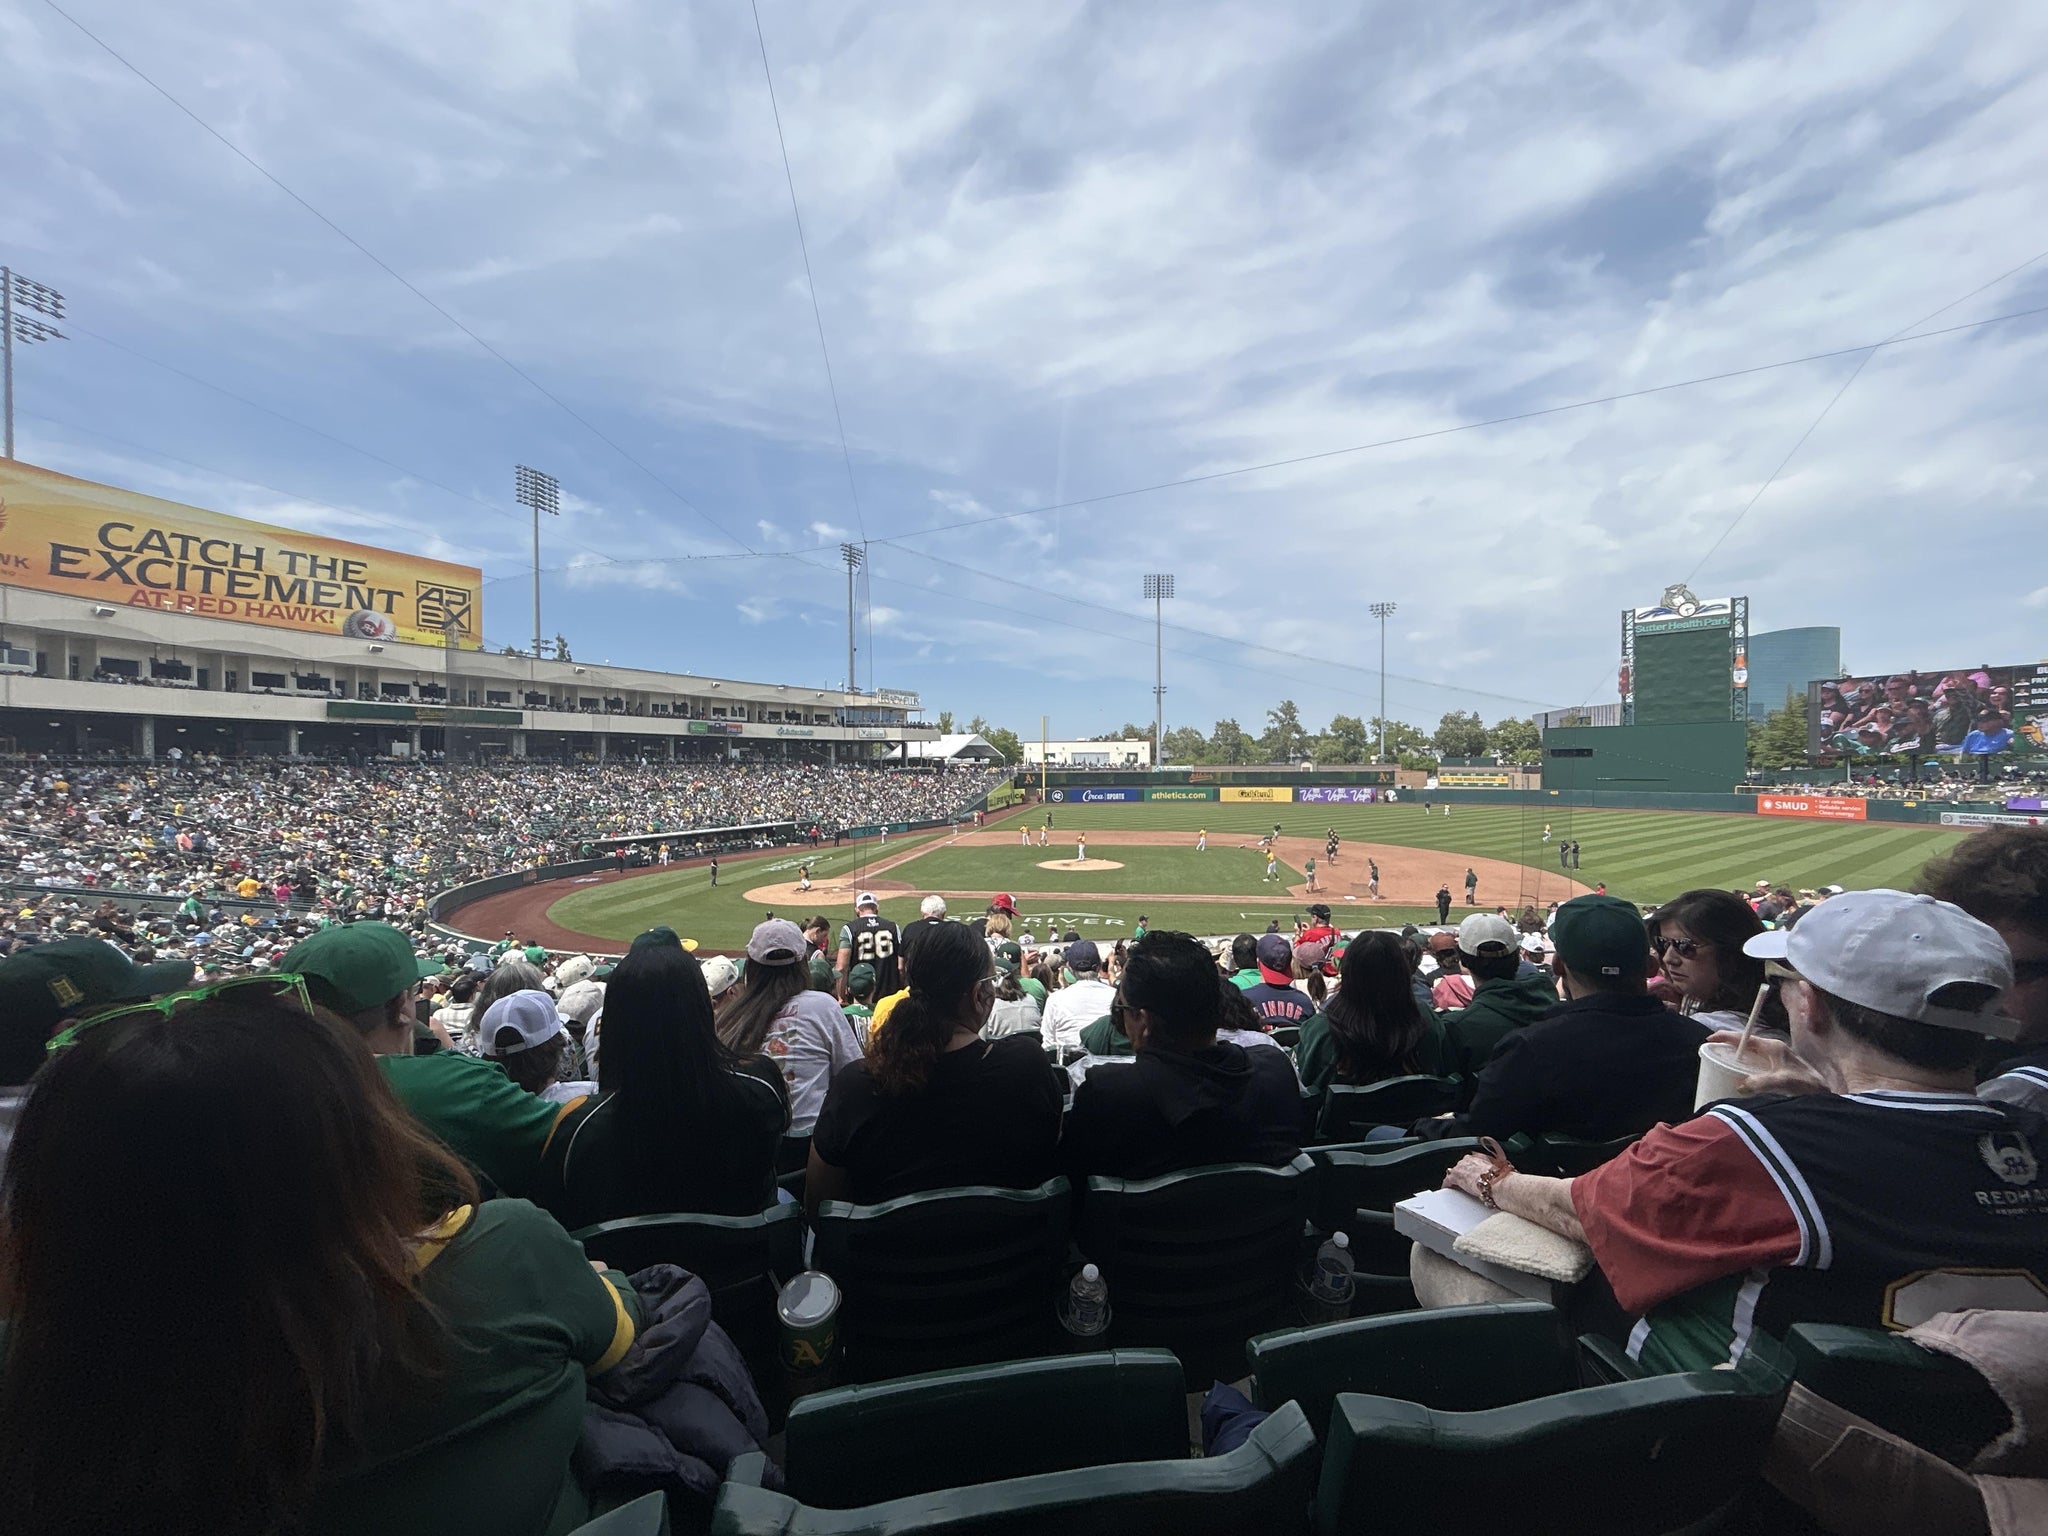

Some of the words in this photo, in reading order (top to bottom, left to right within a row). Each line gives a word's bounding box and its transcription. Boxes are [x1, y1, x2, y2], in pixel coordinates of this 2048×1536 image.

[97, 521, 265, 572] CATCH
[278, 550, 369, 584] THE
[48, 542, 404, 614] EXCITEMENT
[126, 589, 169, 608] AT
[176, 594, 238, 615] RED
[244, 602, 335, 624] HAWK!
[1635, 623, 1667, 633] Sutter
[1667, 619, 1703, 630] Health
[1704, 617, 1730, 626] Park
[1082, 790, 1105, 802] Circa
[1151, 790, 1206, 799] athletics.com
[1775, 801, 1809, 811] SMUD
[1023, 917, 1126, 926] RIVER
[857, 930, 894, 960] 26
[1253, 1001, 1303, 1020] LINDOR
[792, 1331, 834, 1366] A's
